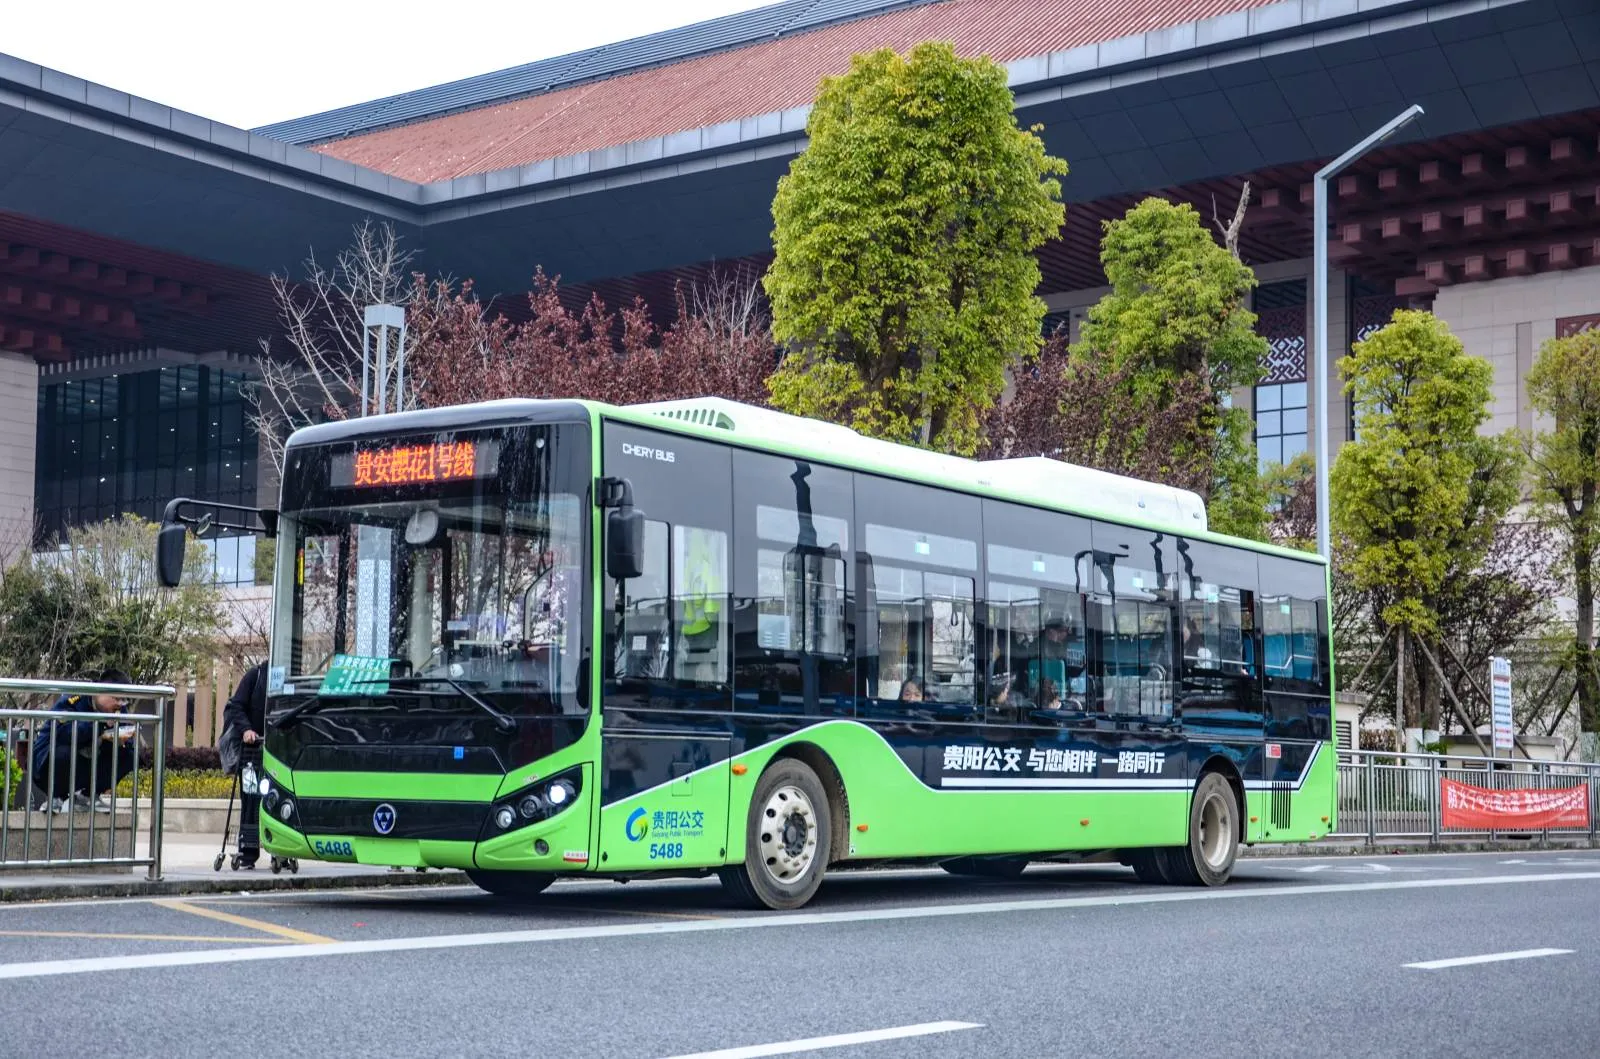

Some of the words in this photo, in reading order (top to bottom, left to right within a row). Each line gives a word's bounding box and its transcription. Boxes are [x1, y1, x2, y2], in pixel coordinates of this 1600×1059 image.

[622, 443, 654, 459] CHERY
[655, 449, 675, 463] BUS
[354, 442, 474, 485] 贵安樱花1号线
[942, 746, 1022, 771] 贵阳公交
[1026, 749, 1097, 773] 与您相伴
[1101, 751, 1165, 773] 一路同行
[652, 809, 704, 829] 贵阳公交
[315, 841, 353, 856] 5488
[650, 843, 683, 859] 5488
